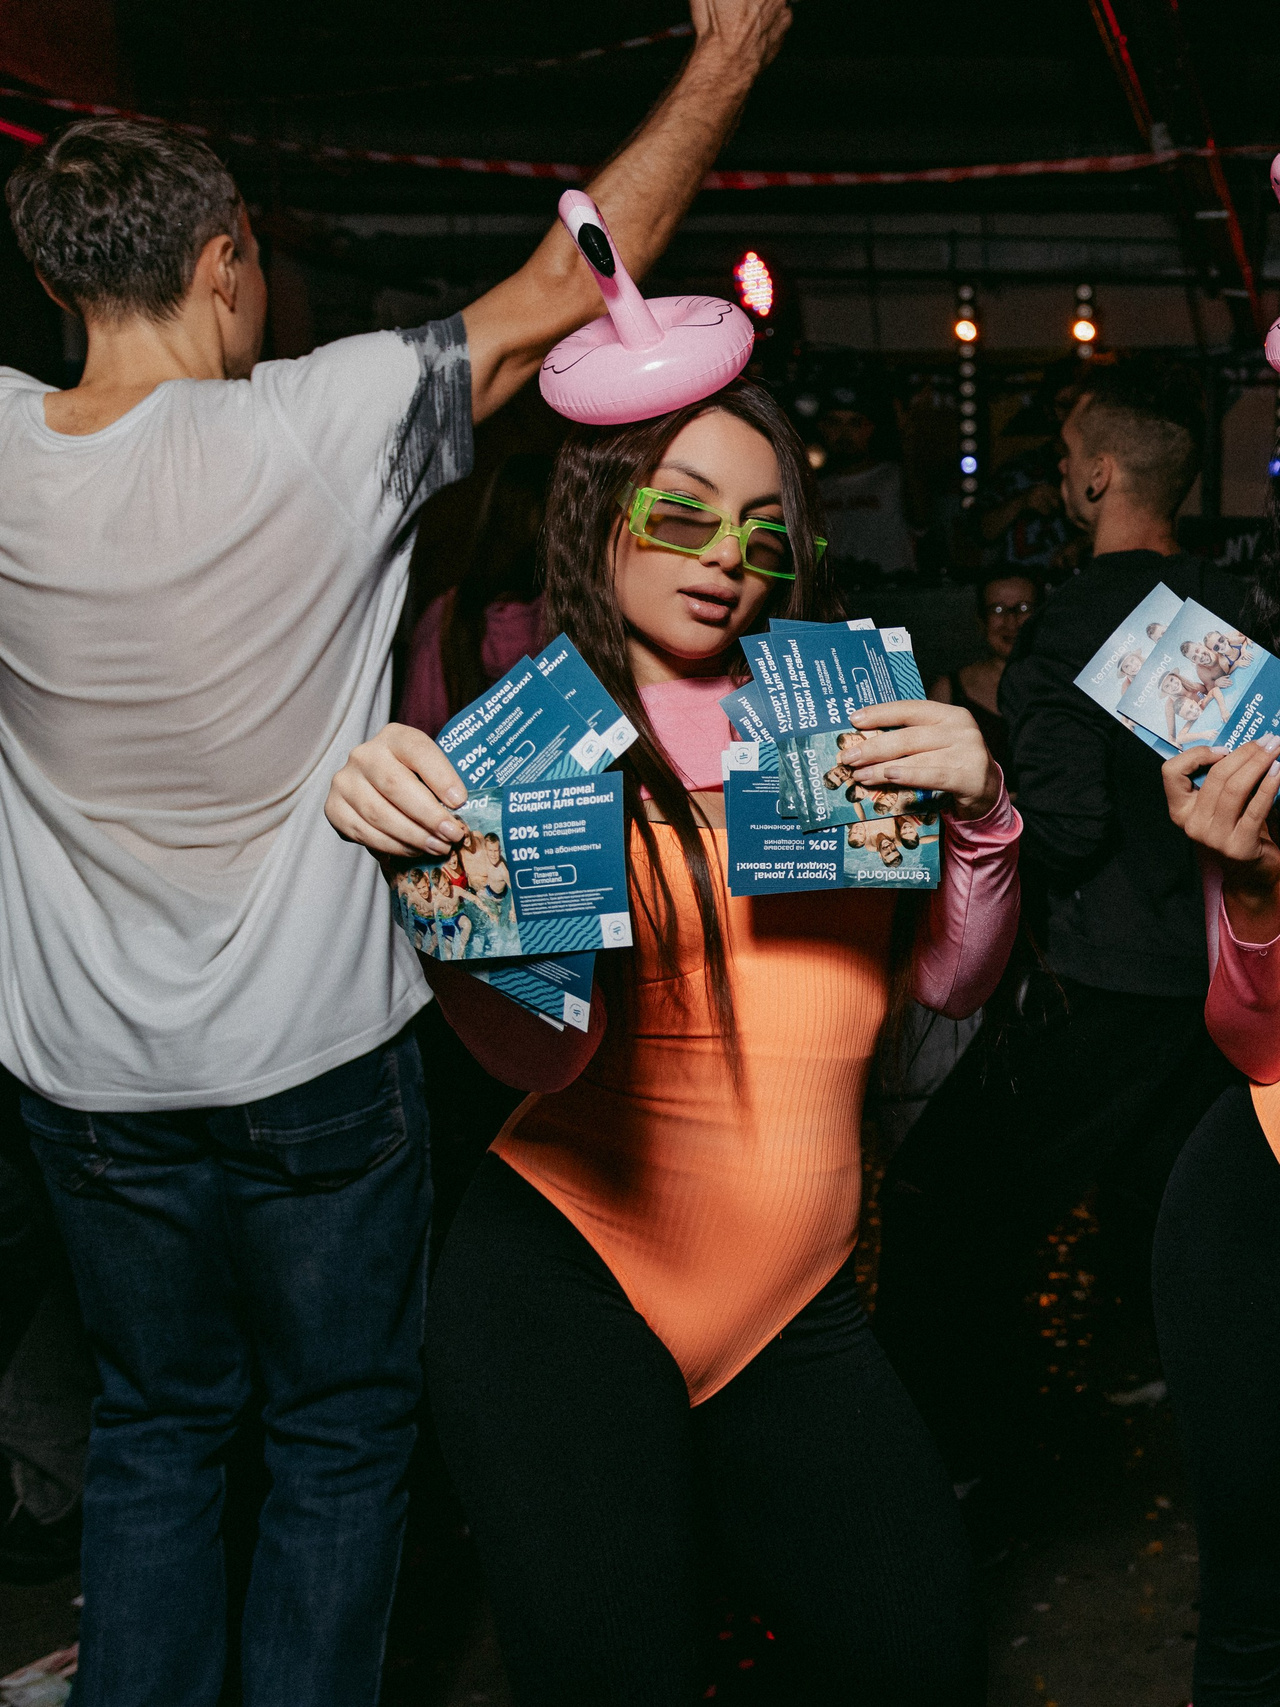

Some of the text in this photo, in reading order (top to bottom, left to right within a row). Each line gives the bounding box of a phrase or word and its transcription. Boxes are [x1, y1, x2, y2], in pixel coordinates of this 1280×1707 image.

[542, 650, 568, 676] воих!
[758, 641, 776, 671] своих!
[783, 655, 798, 680] дома!
[831, 648, 846, 684] абонементы
[1092, 633, 1136, 684] termoland
[755, 658, 773, 684] дома!
[772, 673, 784, 690] для
[788, 640, 817, 727] Скидки для своих!
[814, 660, 827, 686] разовые
[820, 660, 833, 694] посещения
[1133, 654, 1172, 707] termoland
[439, 681, 513, 747] Курорт у дома!
[442, 672, 532, 752] Скидки для своих!
[738, 697, 762, 727] своих!
[770, 696, 790, 733] Курорт
[794, 692, 810, 729] Курорт
[826, 698, 841, 724] 20%
[1222, 694, 1263, 752] риезжайте
[486, 707, 522, 742] на разовые
[490, 710, 523, 745] посещения
[1238, 712, 1265, 748] ыхать!
[458, 744, 487, 771] 20%
[469, 758, 495, 783] 10%
[498, 746, 506, 755] на
[506, 708, 543, 746] абонементы
[510, 783, 594, 804] Курорт у дома!
[804, 749, 826, 821] termoland
[509, 792, 613, 812] Скидки для своих!
[510, 826, 539, 840] 20%
[543, 827, 585, 836] посещения
[554, 820, 586, 830] разовые
[512, 847, 539, 861] 10%
[555, 844, 601, 853] абонементы
[809, 840, 837, 850] 20%
[737, 863, 772, 871] своих!
[755, 870, 836, 880] Курорт у дома!
[797, 862, 836, 870] Скидки
[858, 870, 930, 882] termoland
